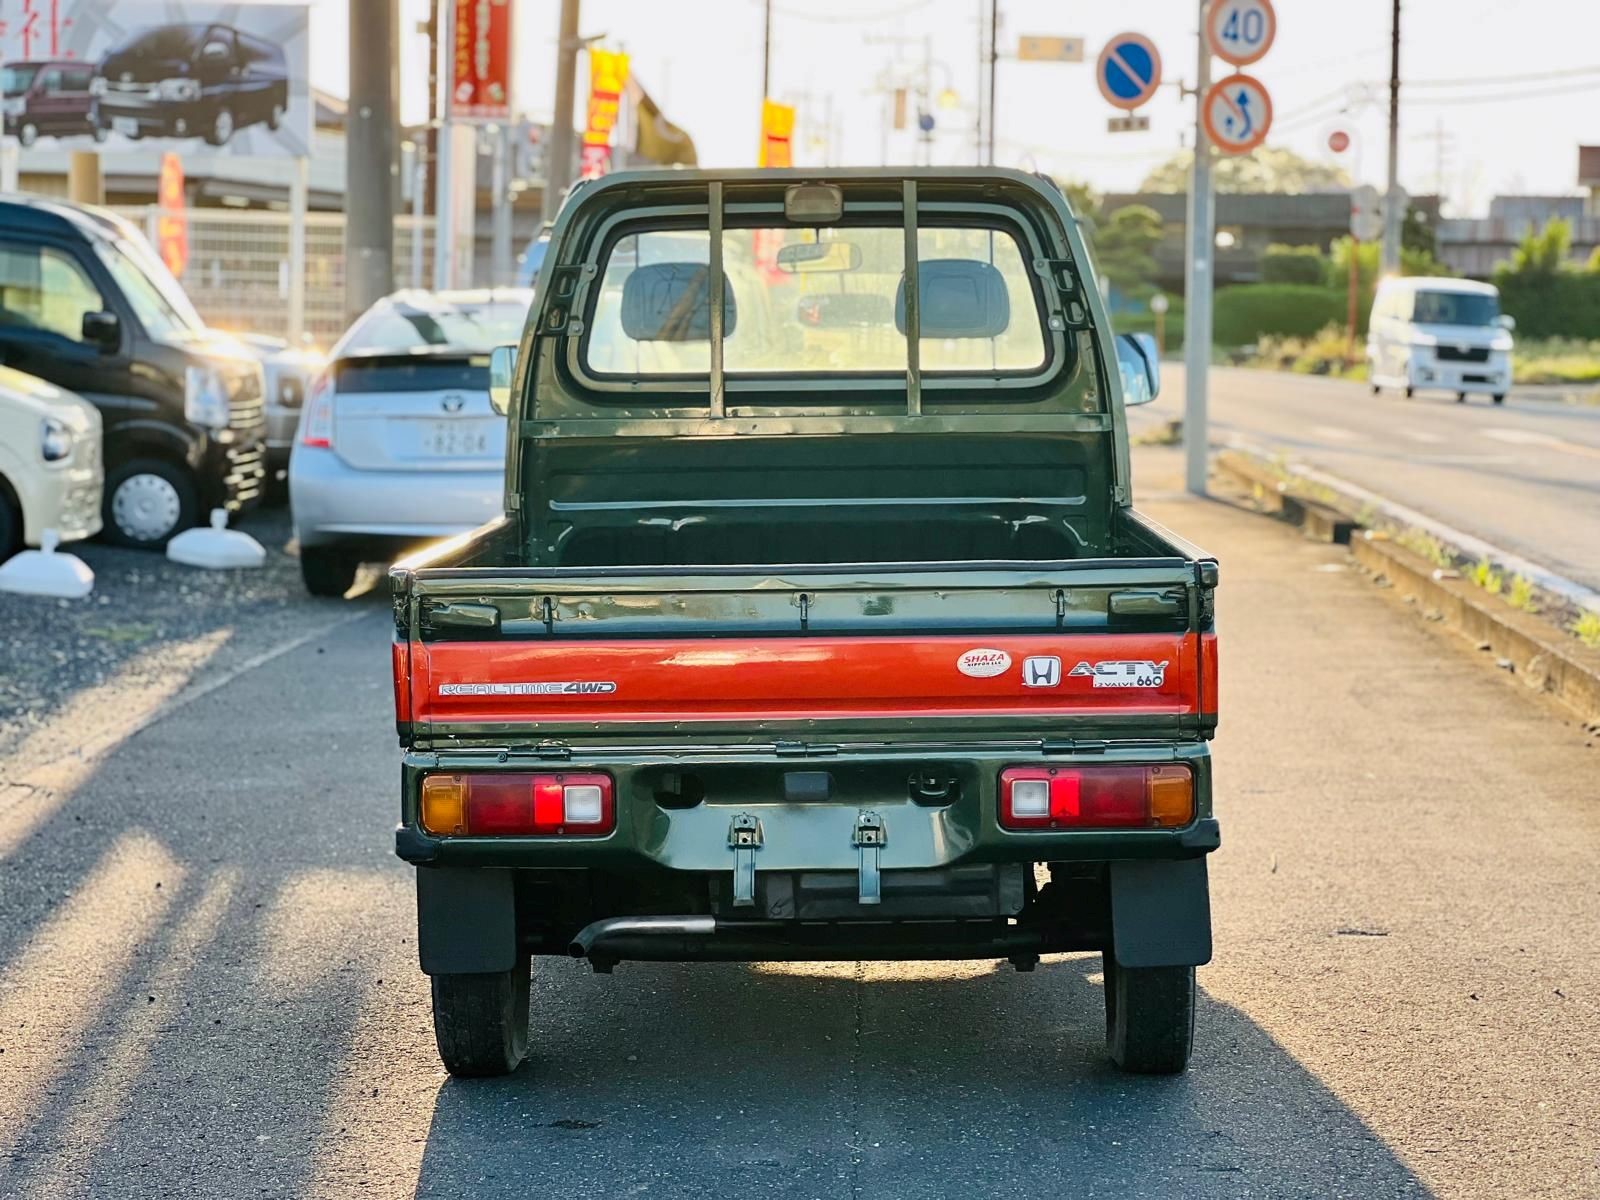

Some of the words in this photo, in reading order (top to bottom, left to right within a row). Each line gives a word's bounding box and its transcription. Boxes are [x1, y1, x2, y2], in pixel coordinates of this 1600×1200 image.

[1222, 8, 1264, 45] 40
[964, 653, 1005, 664] SHAZA
[1069, 661, 1167, 676] ACTY
[1136, 675, 1163, 687] 660
